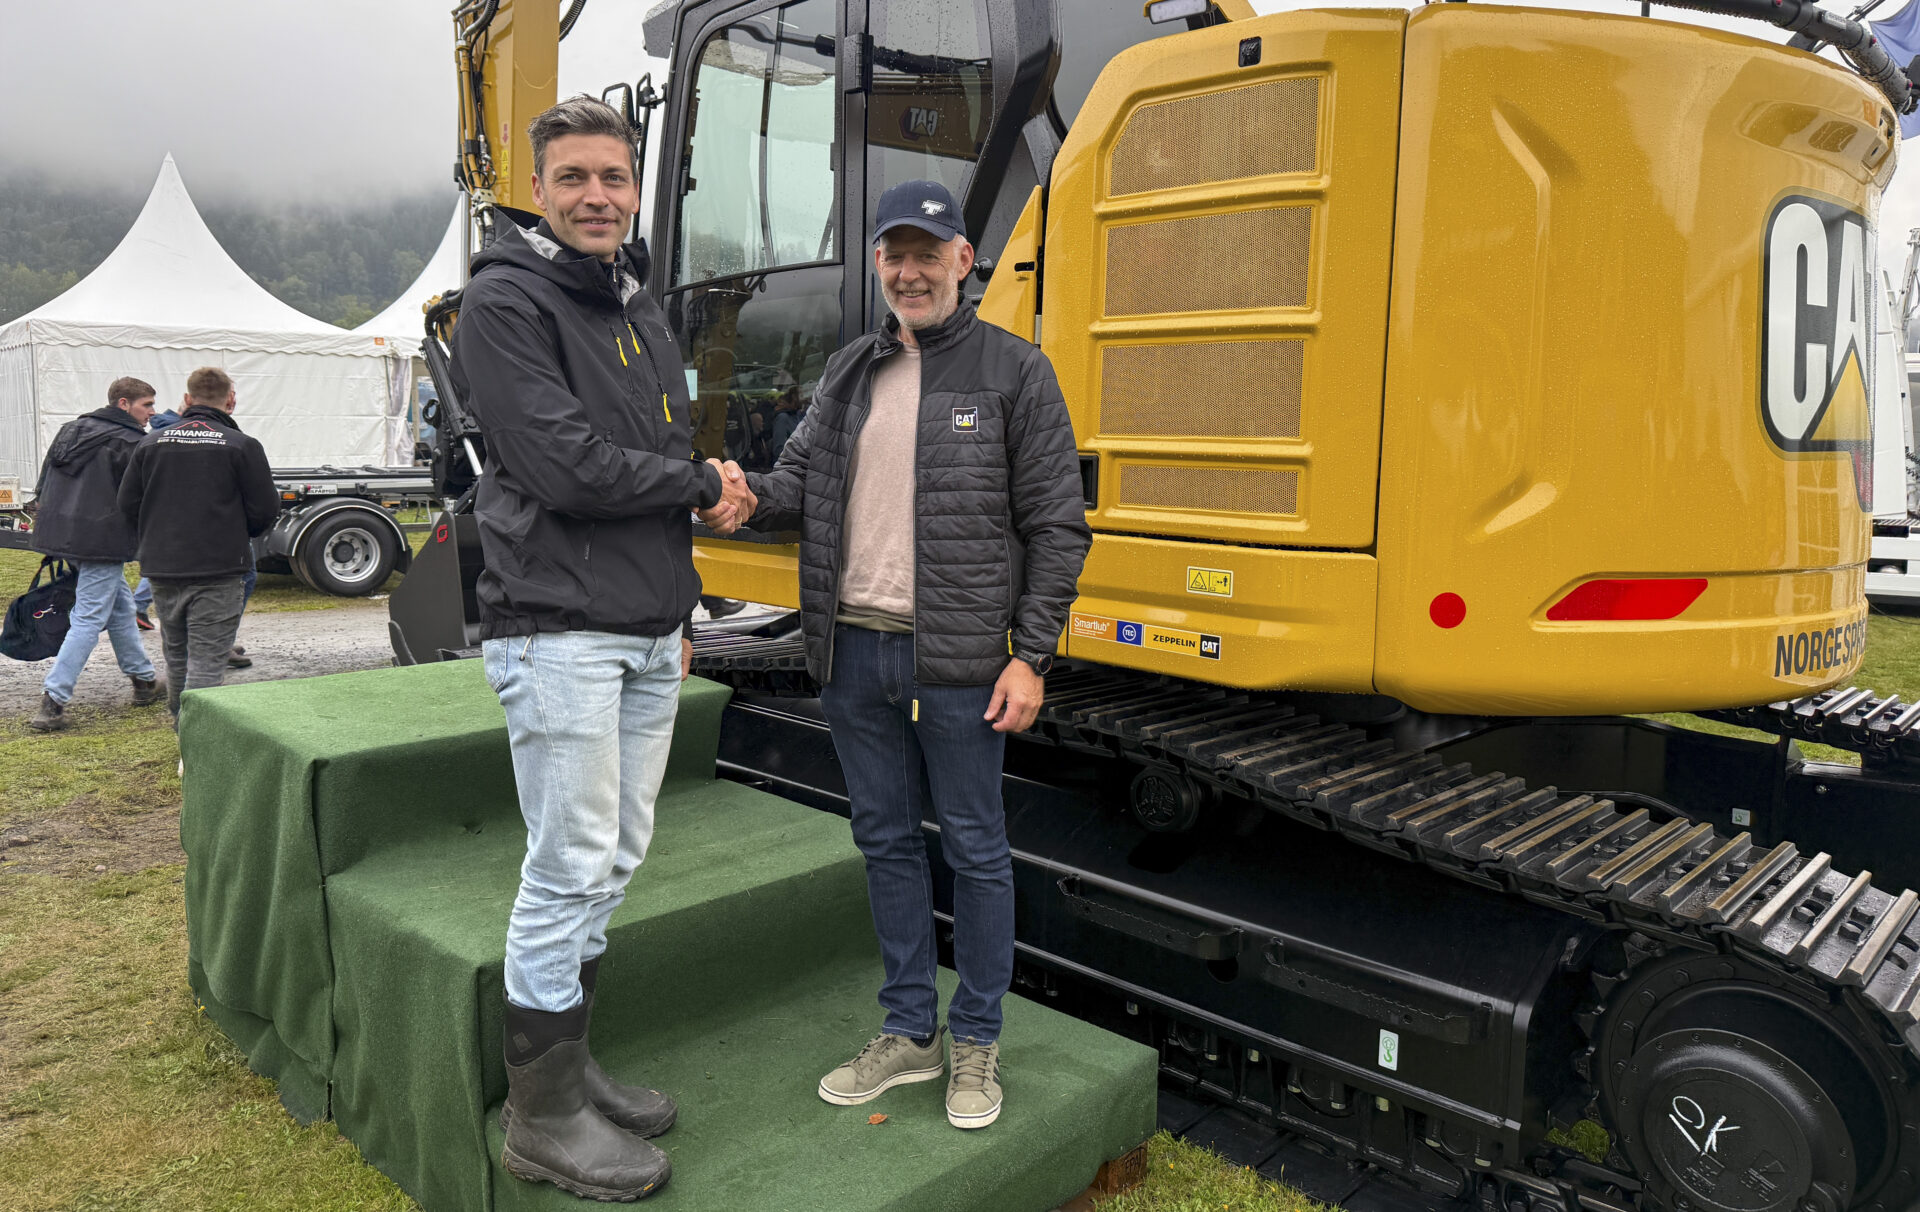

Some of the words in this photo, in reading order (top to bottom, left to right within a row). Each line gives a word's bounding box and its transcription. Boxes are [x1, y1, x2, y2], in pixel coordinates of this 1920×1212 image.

[955, 414, 975, 426] CAT
[163, 429, 224, 438] STAVANGER
[1125, 629, 1134, 637] TEC
[1153, 634, 1196, 648] ZEPPELIN
[1201, 640, 1219, 654] CAT
